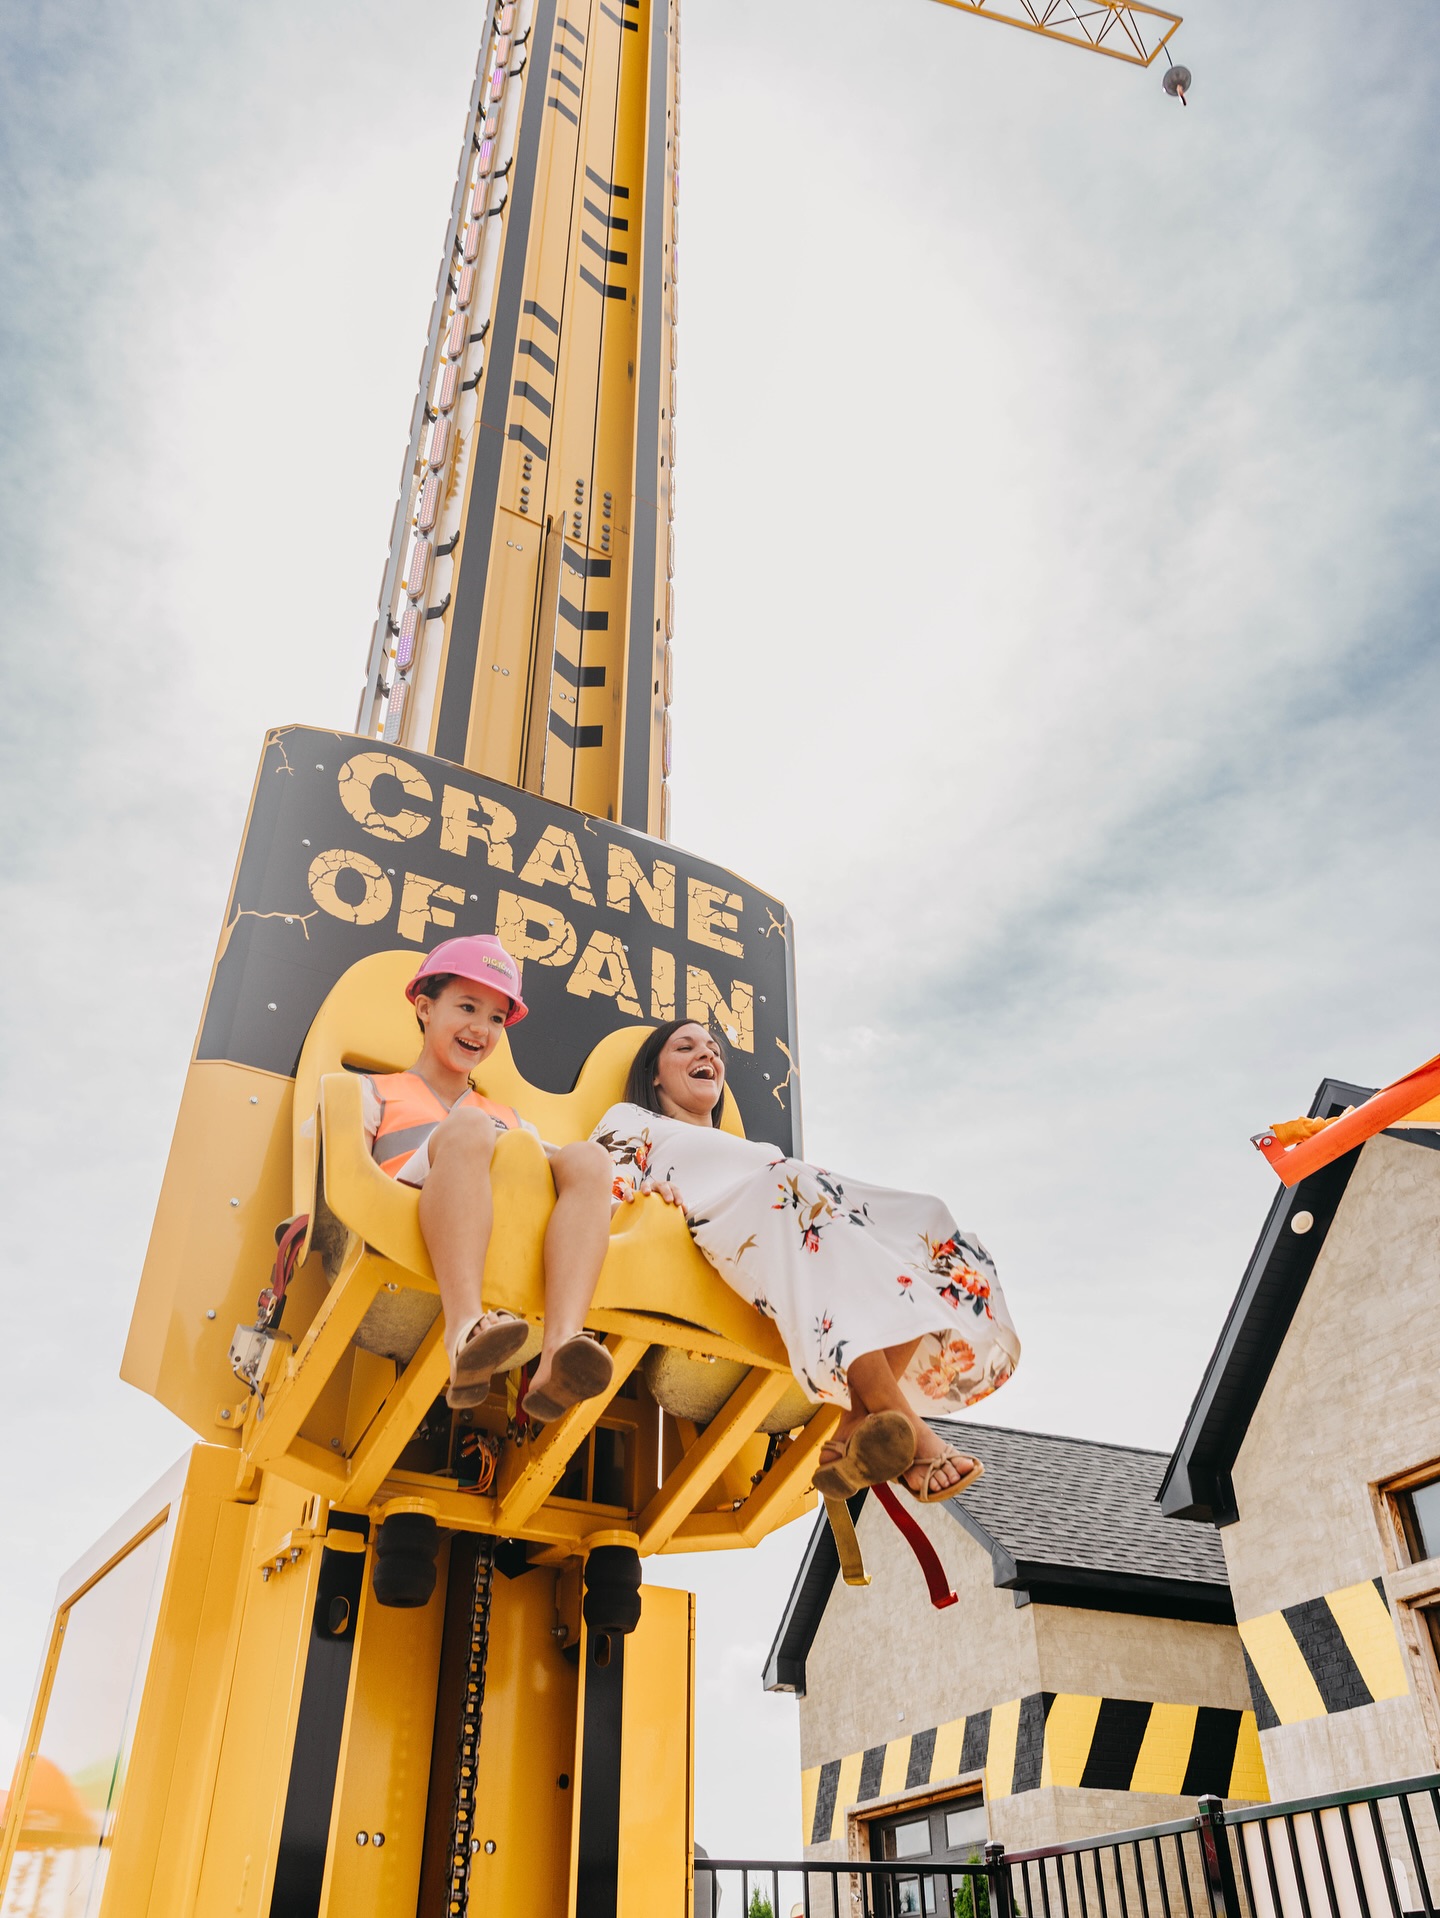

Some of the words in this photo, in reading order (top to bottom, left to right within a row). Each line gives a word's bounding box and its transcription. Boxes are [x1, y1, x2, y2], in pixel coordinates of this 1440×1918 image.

[307, 849, 466, 943] OF
[494, 889, 755, 1054] PAIN
[337, 752, 745, 959] CRANE
